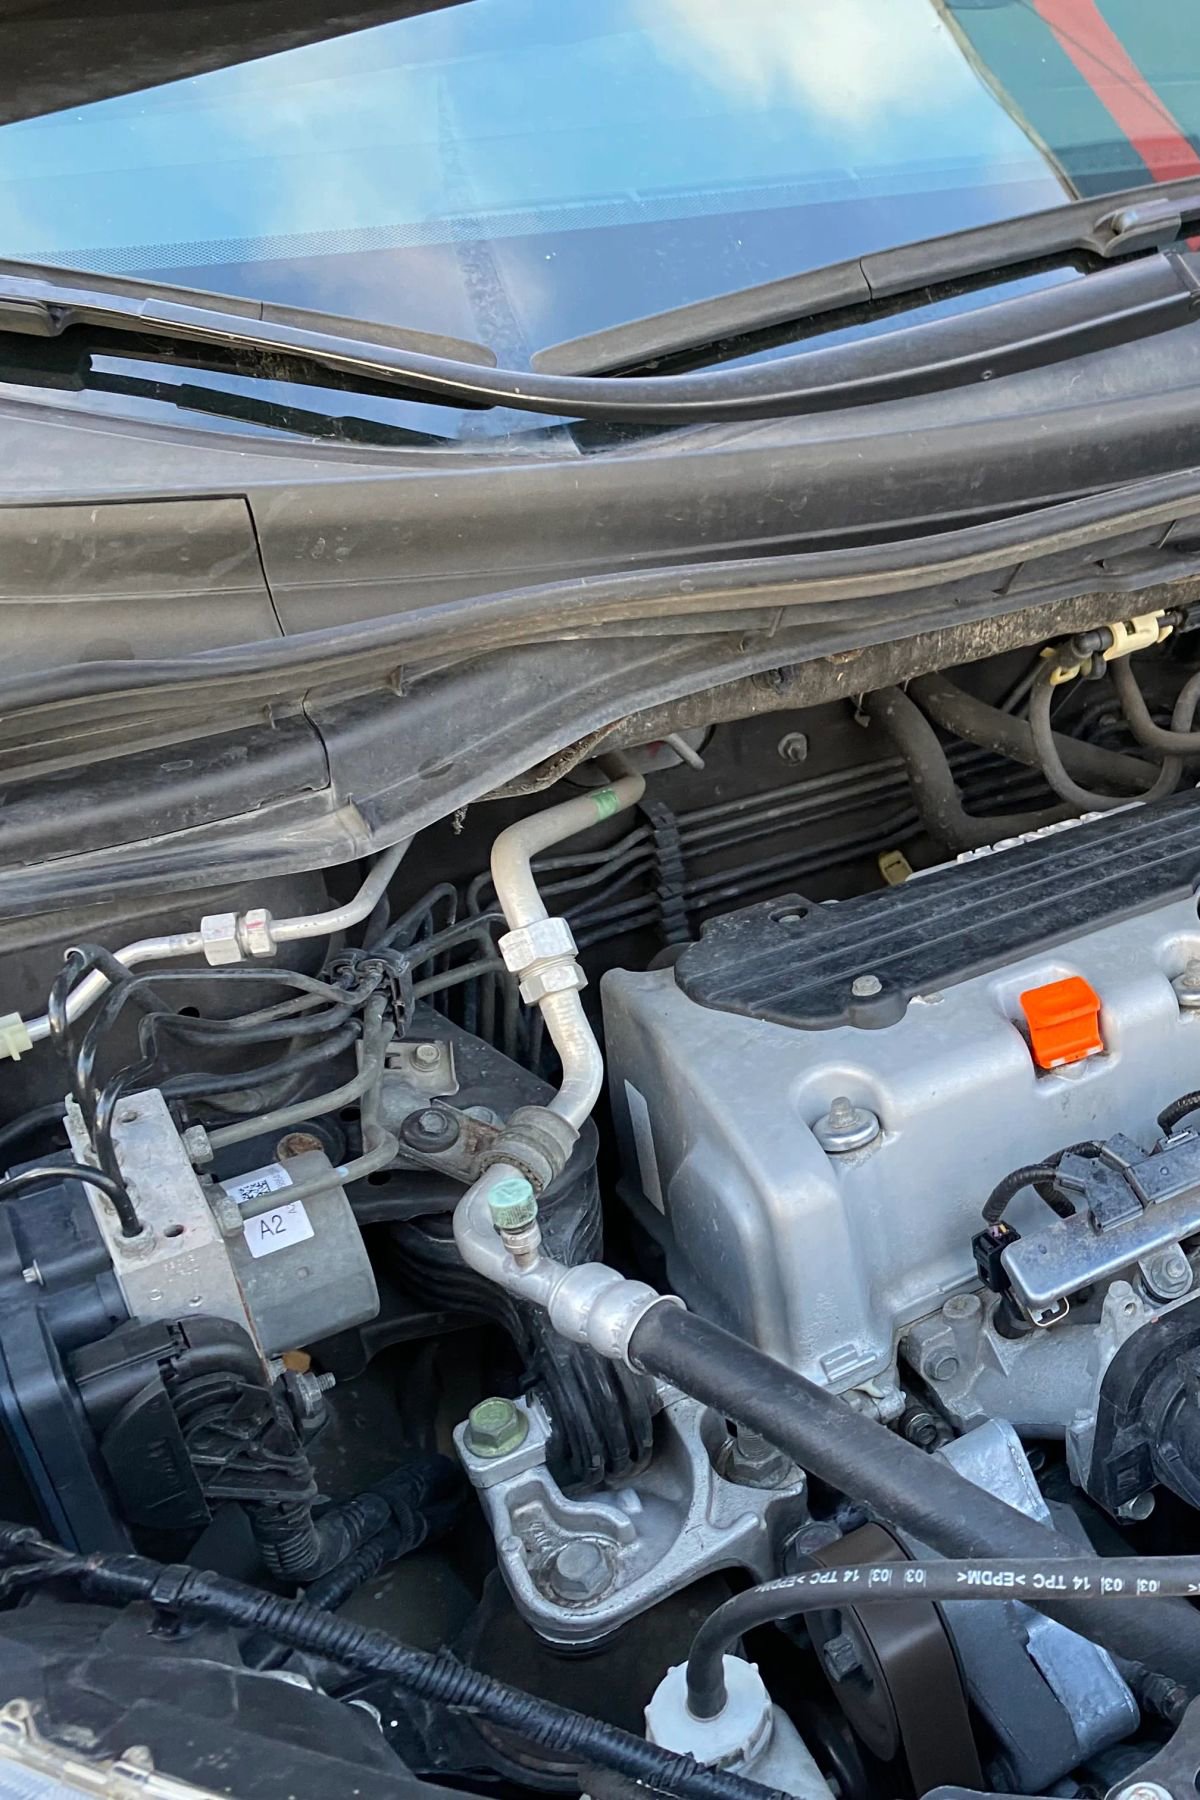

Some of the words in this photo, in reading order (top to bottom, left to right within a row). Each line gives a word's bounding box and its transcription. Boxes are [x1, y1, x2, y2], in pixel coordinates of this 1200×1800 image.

[260, 1214, 287, 1240] A2
[808, 1570, 838, 1585] TPC
[843, 1569, 860, 1583] 14
[1032, 1573, 1067, 1589] TPC
[1072, 1576, 1091, 1590] 14
